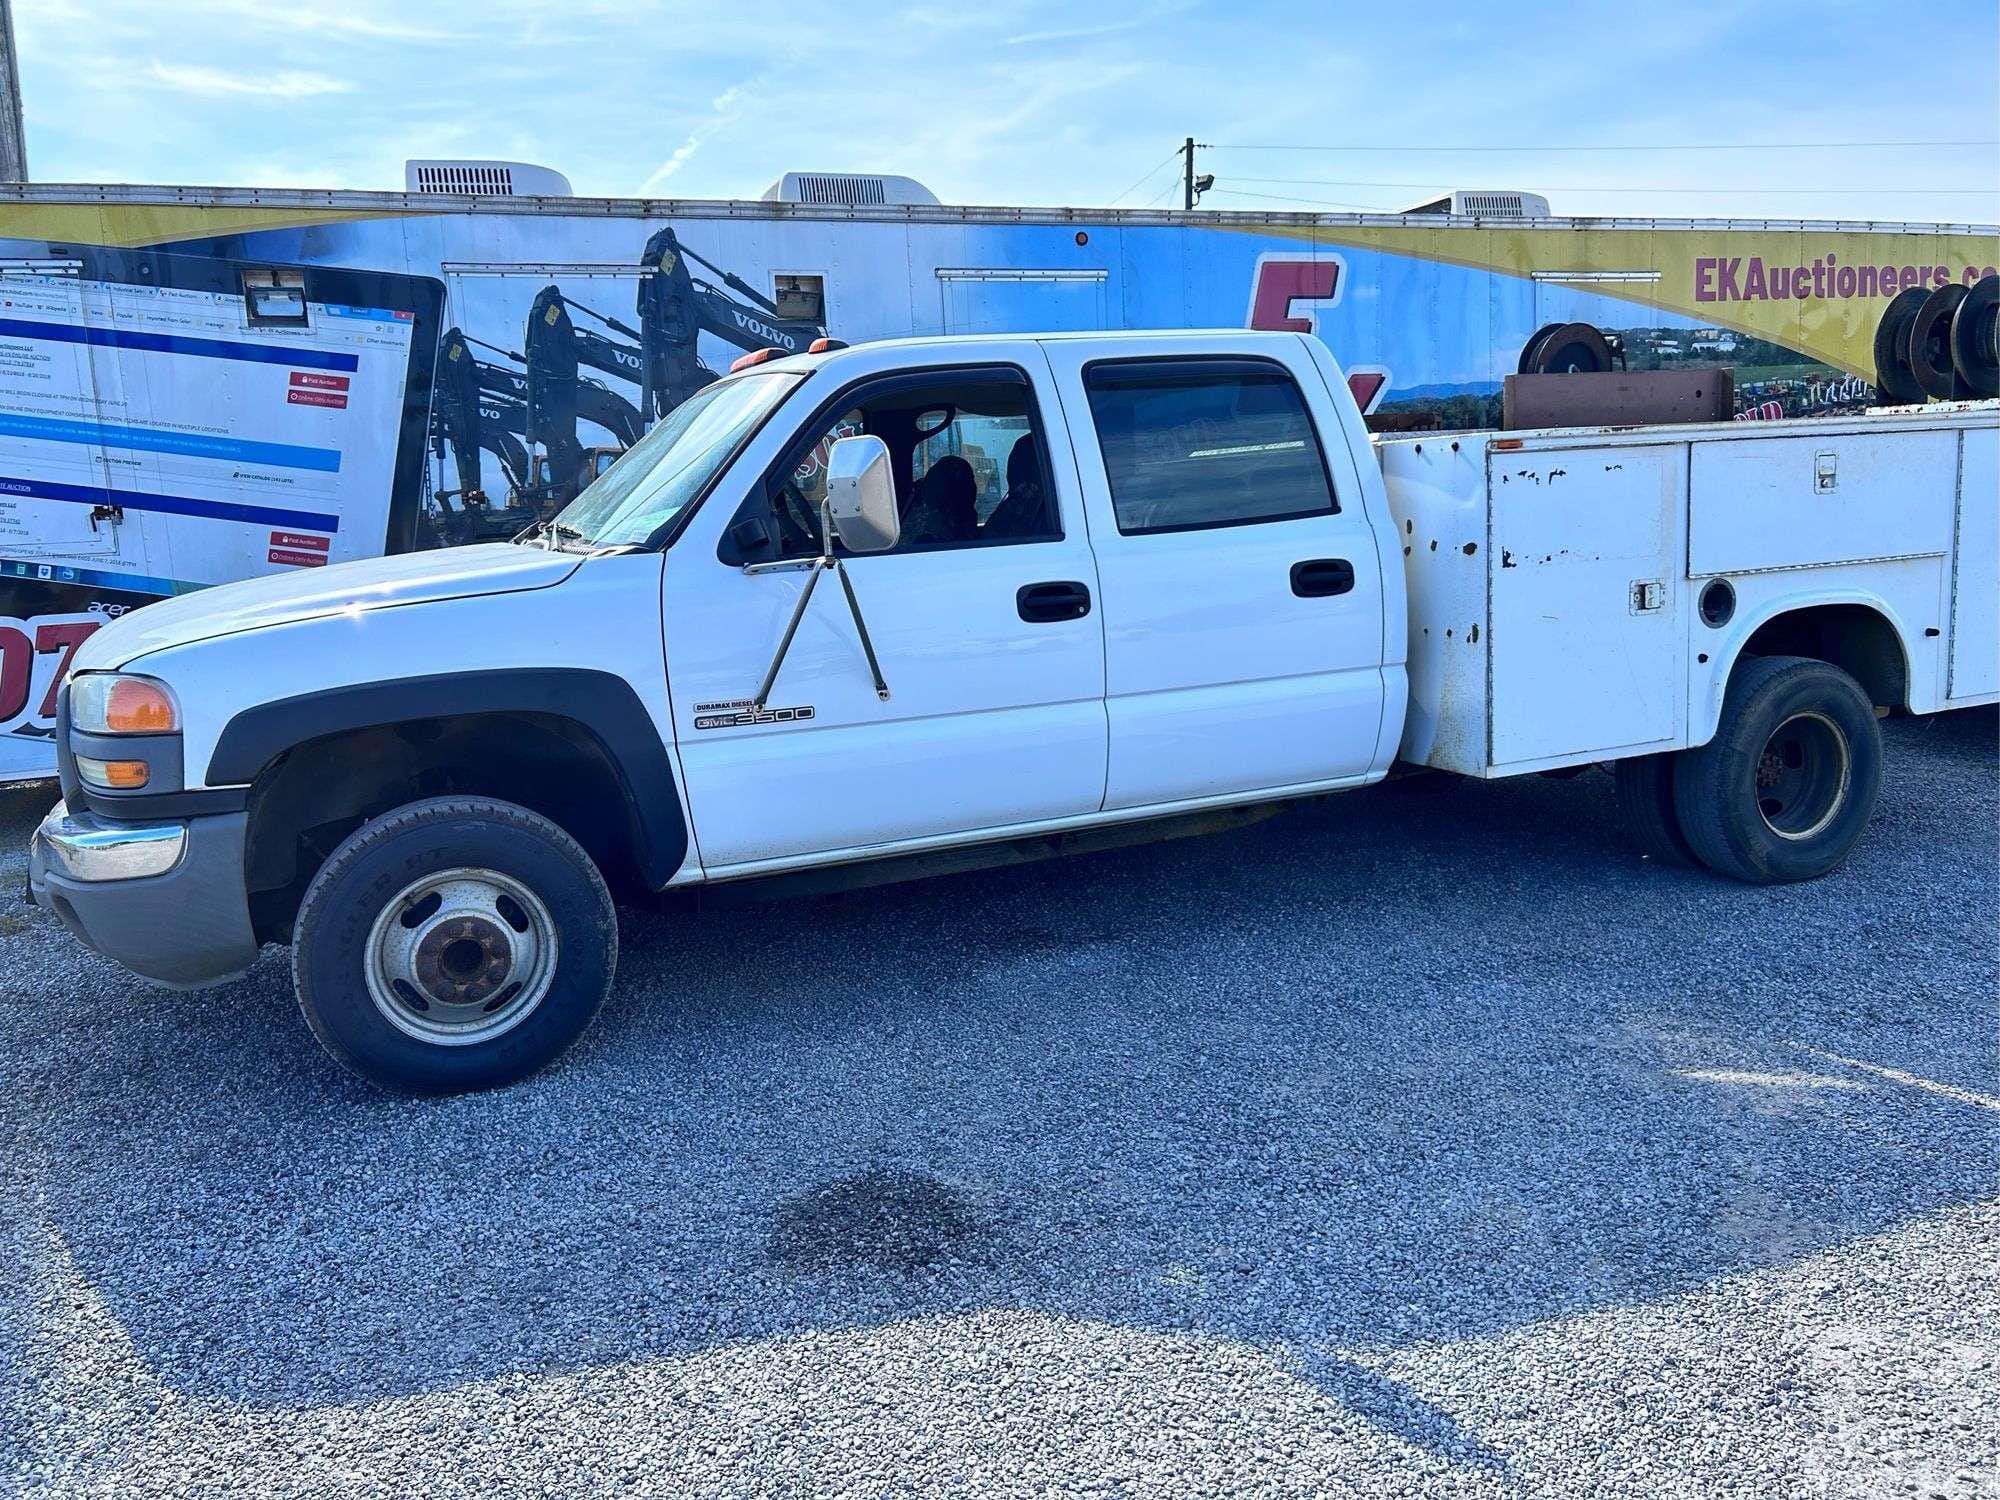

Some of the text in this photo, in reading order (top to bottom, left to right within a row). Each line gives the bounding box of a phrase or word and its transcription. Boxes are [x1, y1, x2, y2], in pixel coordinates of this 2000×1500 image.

[731, 310, 796, 350] VOLVO
[87, 601, 131, 616] acer
[696, 700, 753, 712] DURAMAX DIESEL
